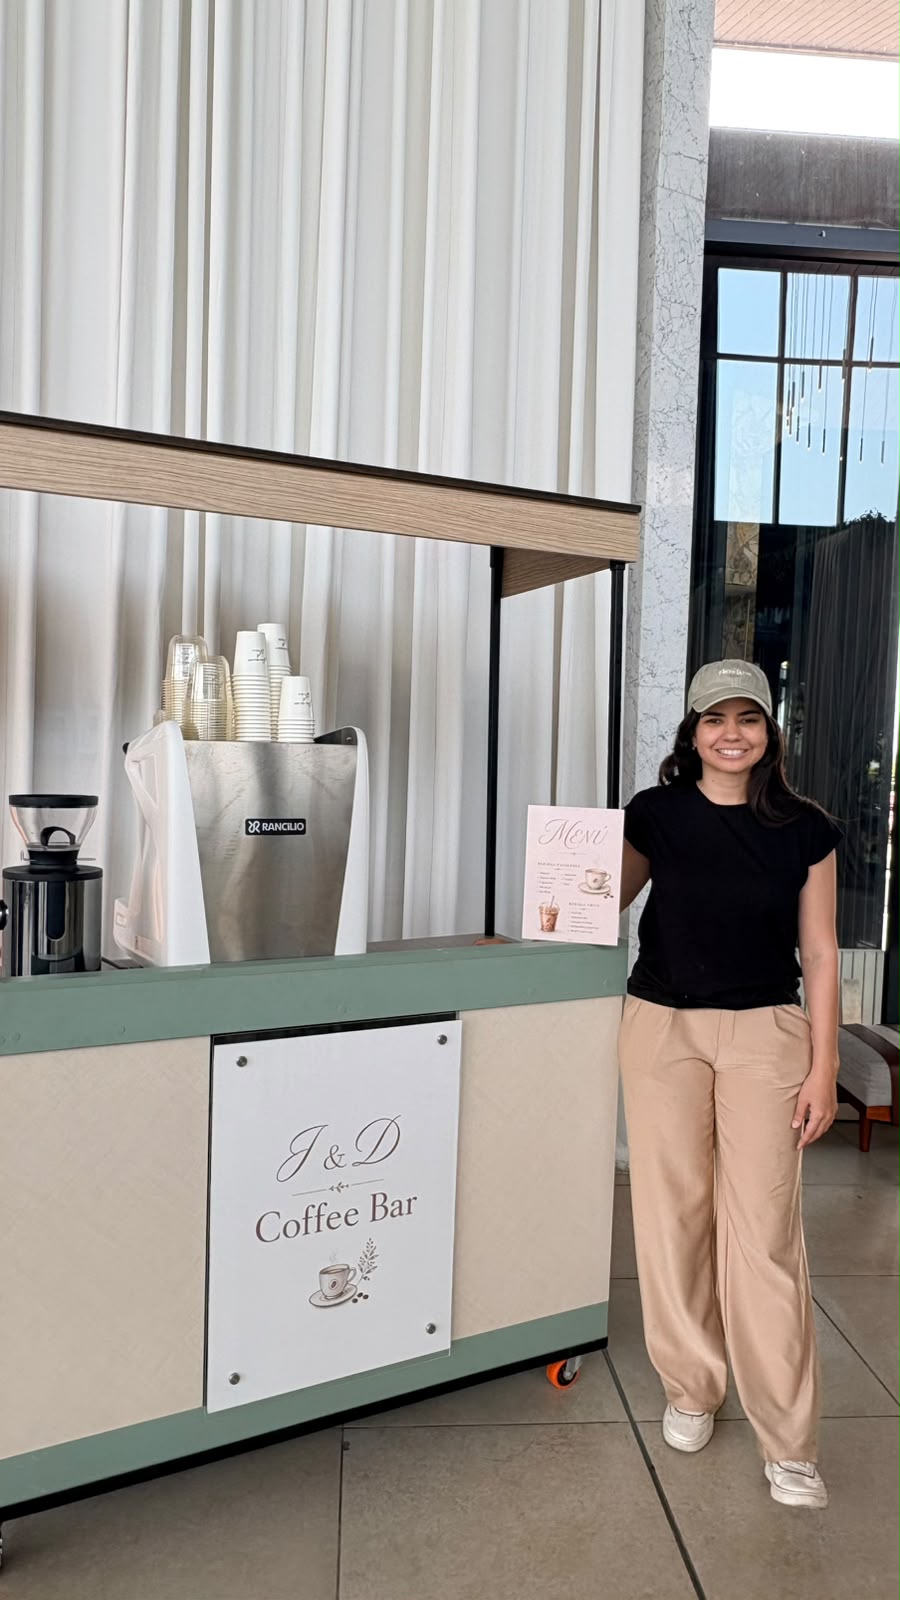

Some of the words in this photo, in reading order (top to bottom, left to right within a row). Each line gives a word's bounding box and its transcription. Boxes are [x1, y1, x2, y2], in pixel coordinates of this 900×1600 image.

[262, 823, 304, 831] RANCILIO
[276, 1124, 328, 1182] J
[323, 1144, 347, 1170] &
[351, 1115, 401, 1167] D
[256, 1201, 359, 1243] Coffee
[370, 1192, 417, 1223] Bar
